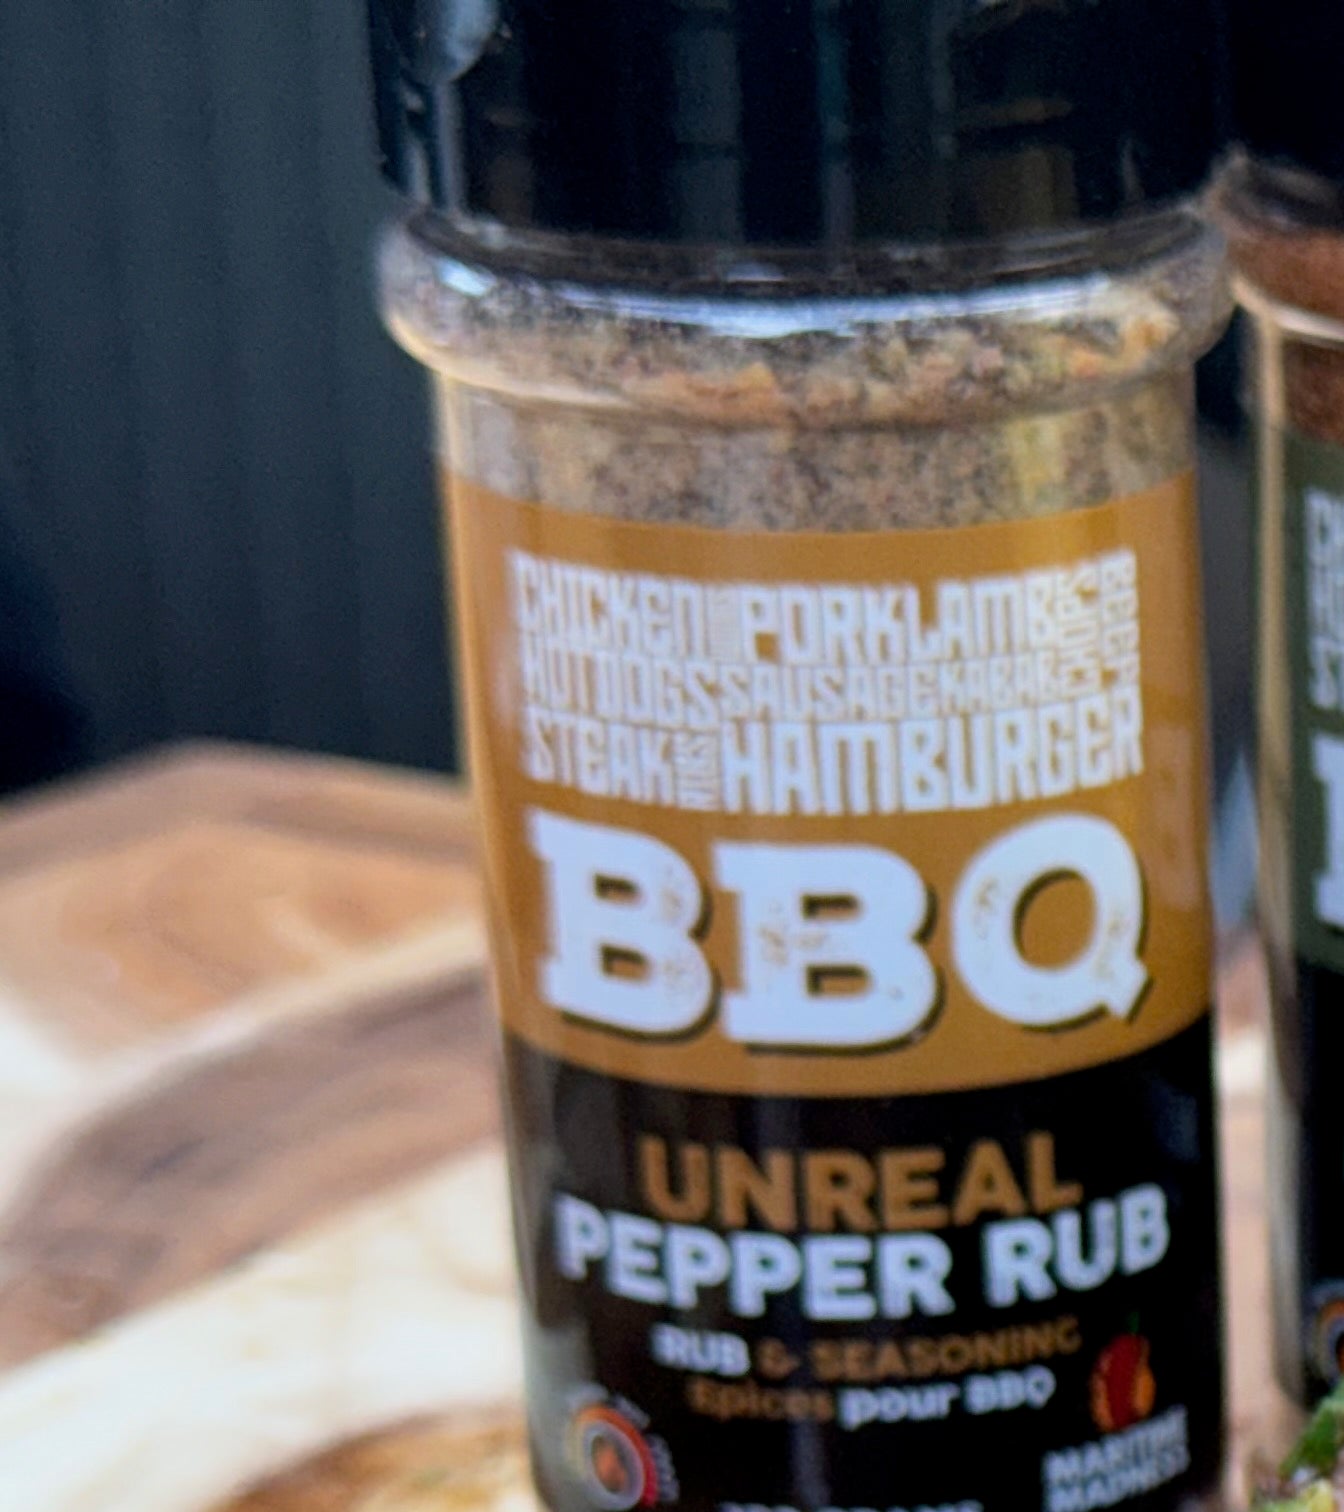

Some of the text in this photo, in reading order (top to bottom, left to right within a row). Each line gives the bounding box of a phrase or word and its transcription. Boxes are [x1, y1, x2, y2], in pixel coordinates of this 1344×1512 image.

[509, 548, 706, 660] CHICKEN
[741, 582, 905, 664] PORK
[907, 566, 1057, 662] LAMB
[720, 660, 938, 722] SAUSAGE
[522, 706, 674, 807] STEAK
[722, 686, 1144, 816] HAMBURGER
[527, 805, 1152, 1050] BBQ
[636, 1129, 1084, 1231] UNREAL
[553, 1183, 1172, 1322] PEPPER RUB
[651, 1315, 1084, 1384] RUB & SEASONING
[837, 1380, 961, 1430] pour
[963, 1365, 1056, 1413] BBQ
